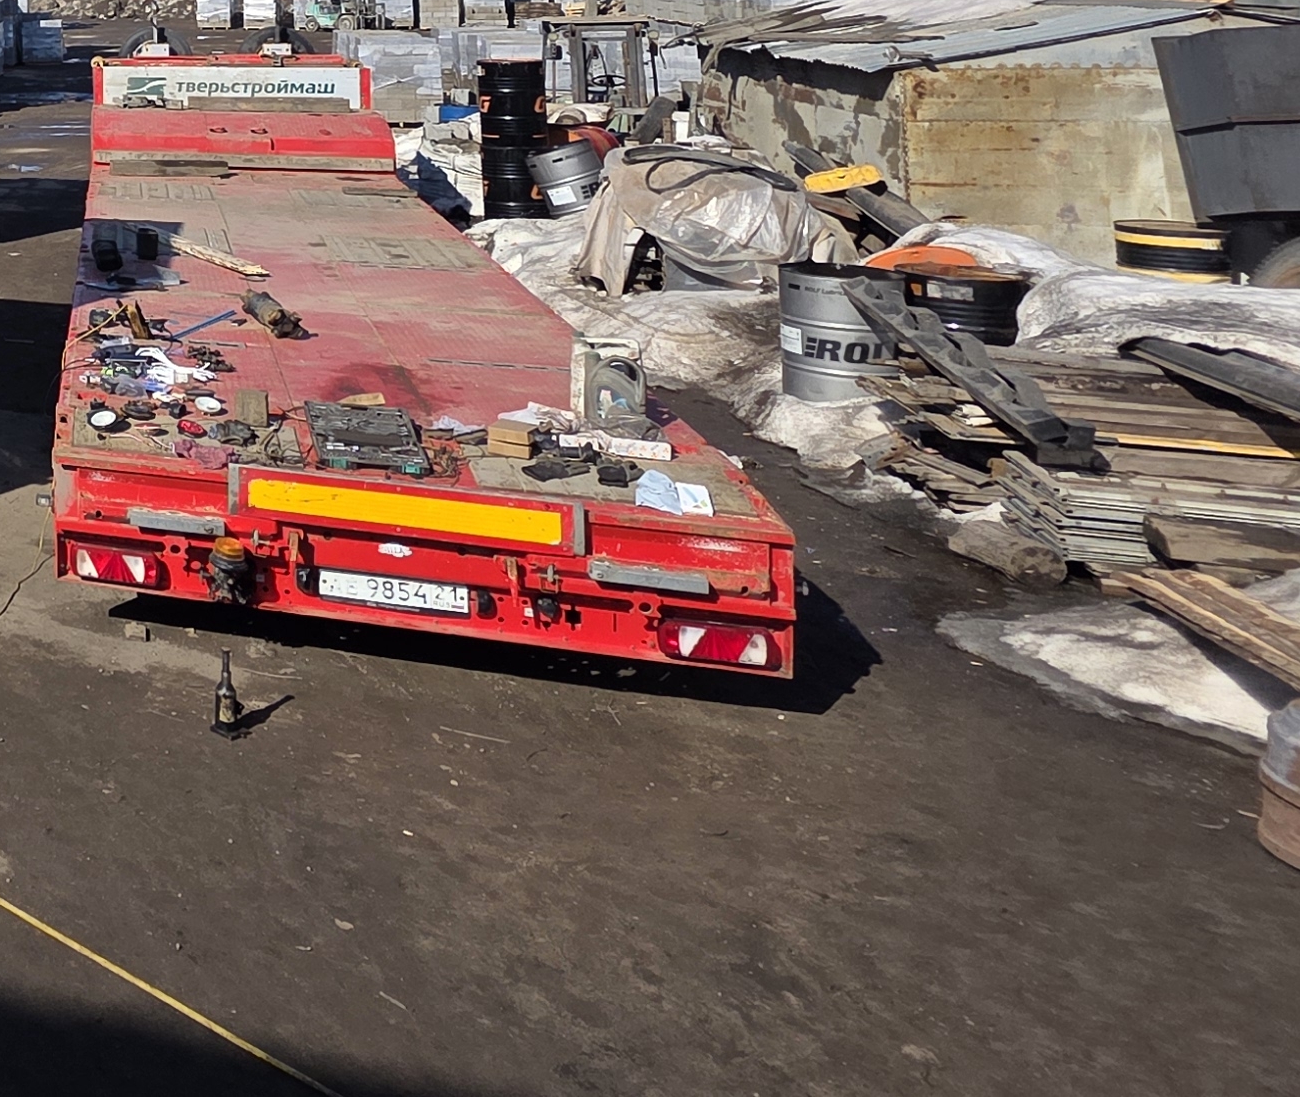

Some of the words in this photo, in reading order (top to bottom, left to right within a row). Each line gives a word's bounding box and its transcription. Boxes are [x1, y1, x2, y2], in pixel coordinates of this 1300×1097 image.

[176, 80, 335, 97] тверьстроймаш
[367, 578, 427, 604] 9854
[434, 585, 457, 602] 21
